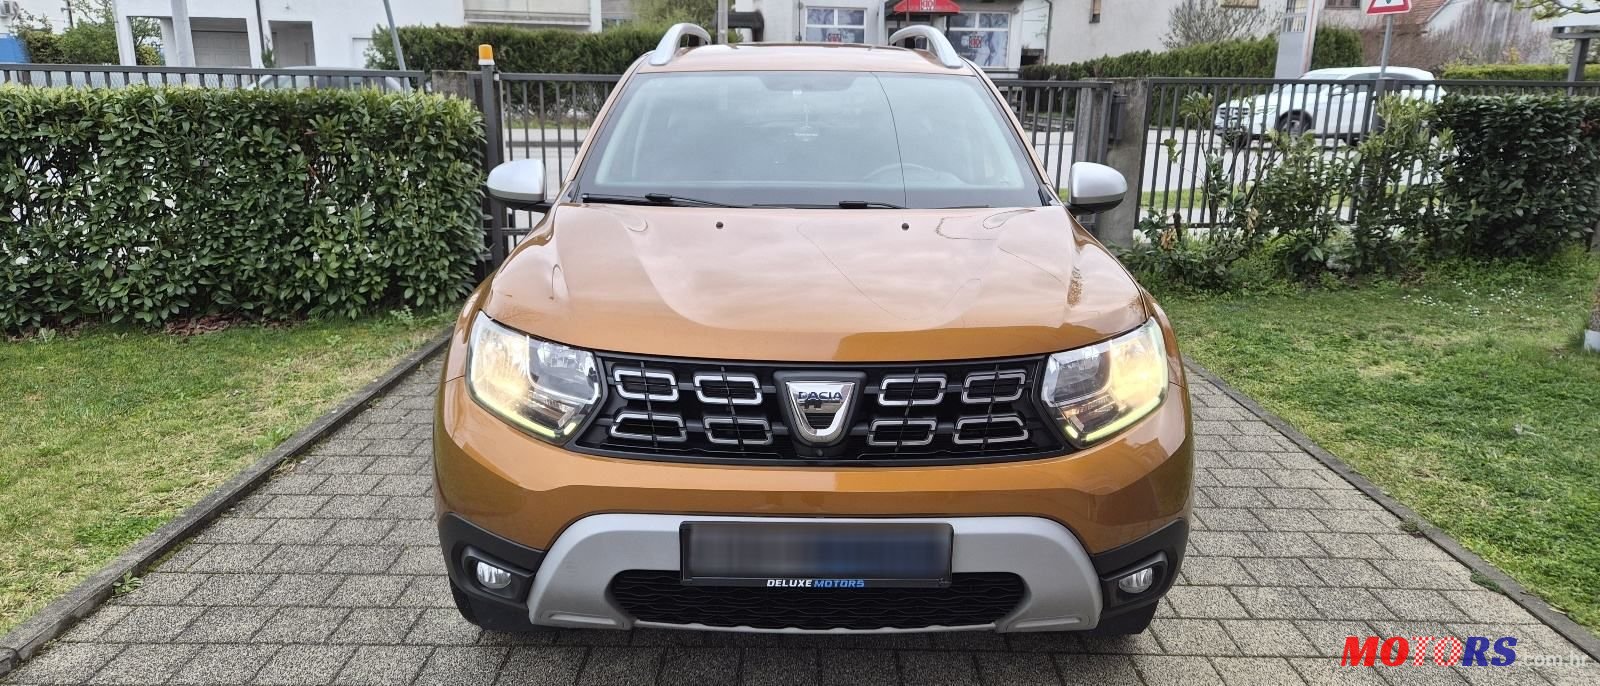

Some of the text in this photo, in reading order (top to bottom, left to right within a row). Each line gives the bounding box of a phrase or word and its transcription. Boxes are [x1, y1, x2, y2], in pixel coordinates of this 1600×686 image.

[798, 391, 843, 400] DACIA
[766, 579, 865, 588] DELUXE MOTORS
